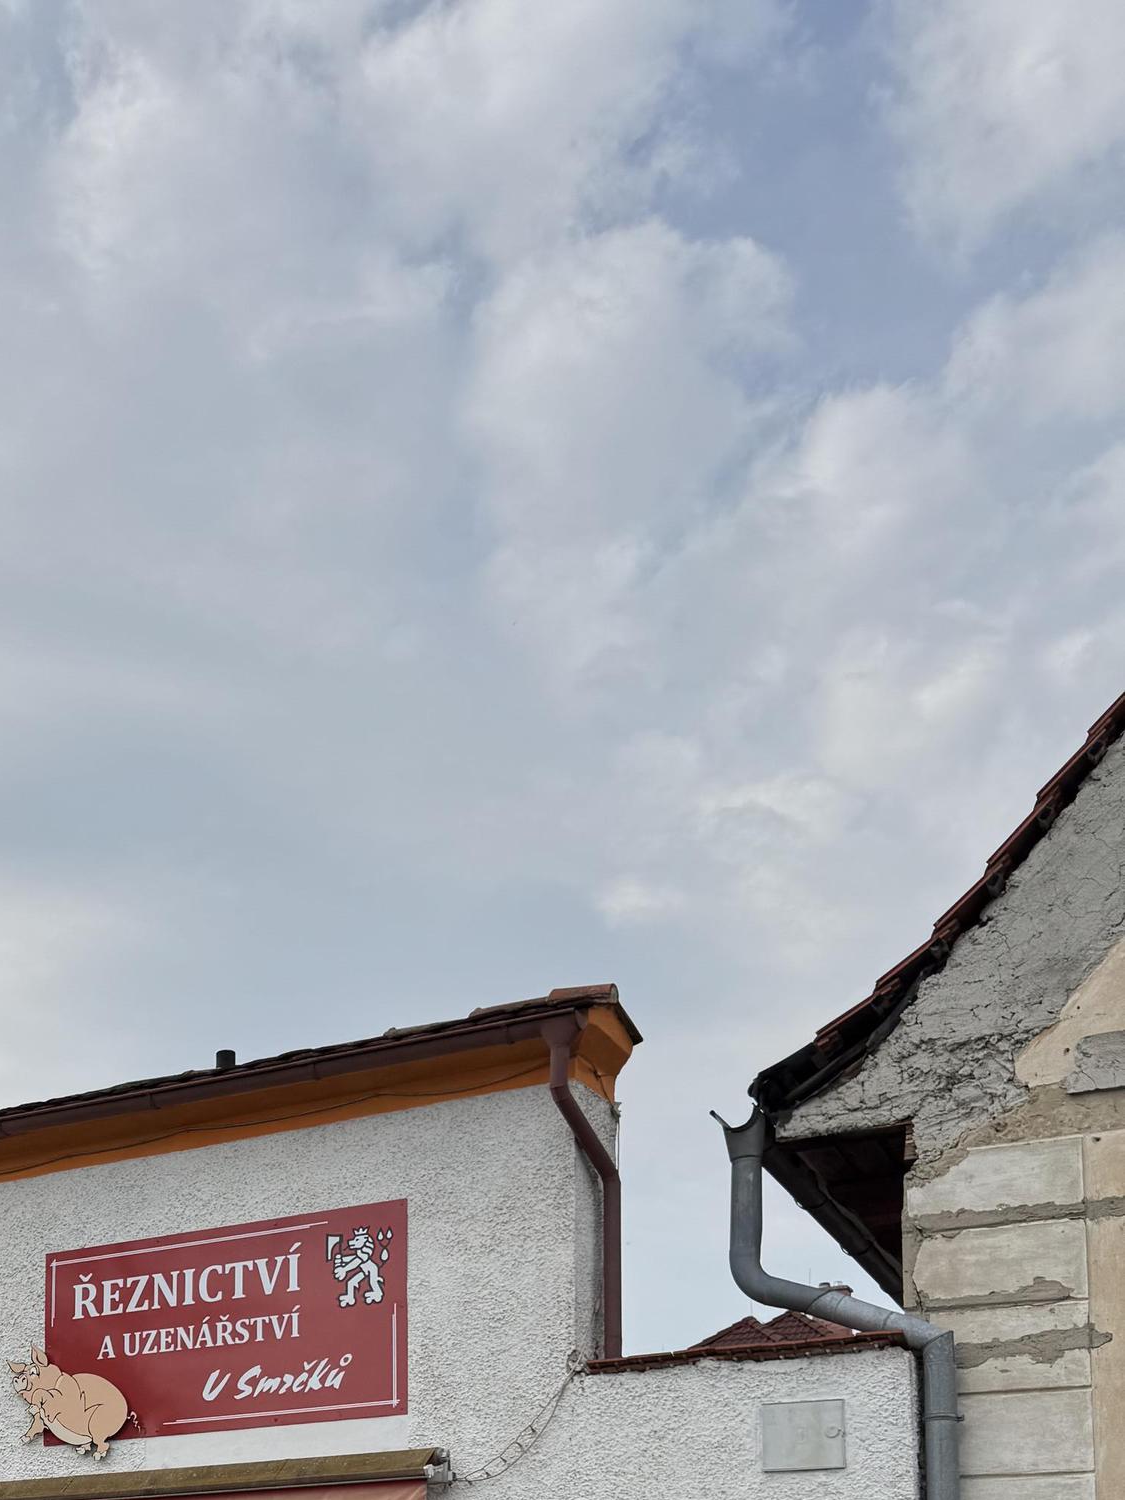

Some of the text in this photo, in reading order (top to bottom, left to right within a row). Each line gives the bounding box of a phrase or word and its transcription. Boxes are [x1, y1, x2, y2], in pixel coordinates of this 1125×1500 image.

[72, 1242, 301, 1319] ŘEZNICTVÍ
[97, 1305, 300, 1360] A UZENÁŘSTVÍ
[202, 1354, 353, 1401] U Smrčků
